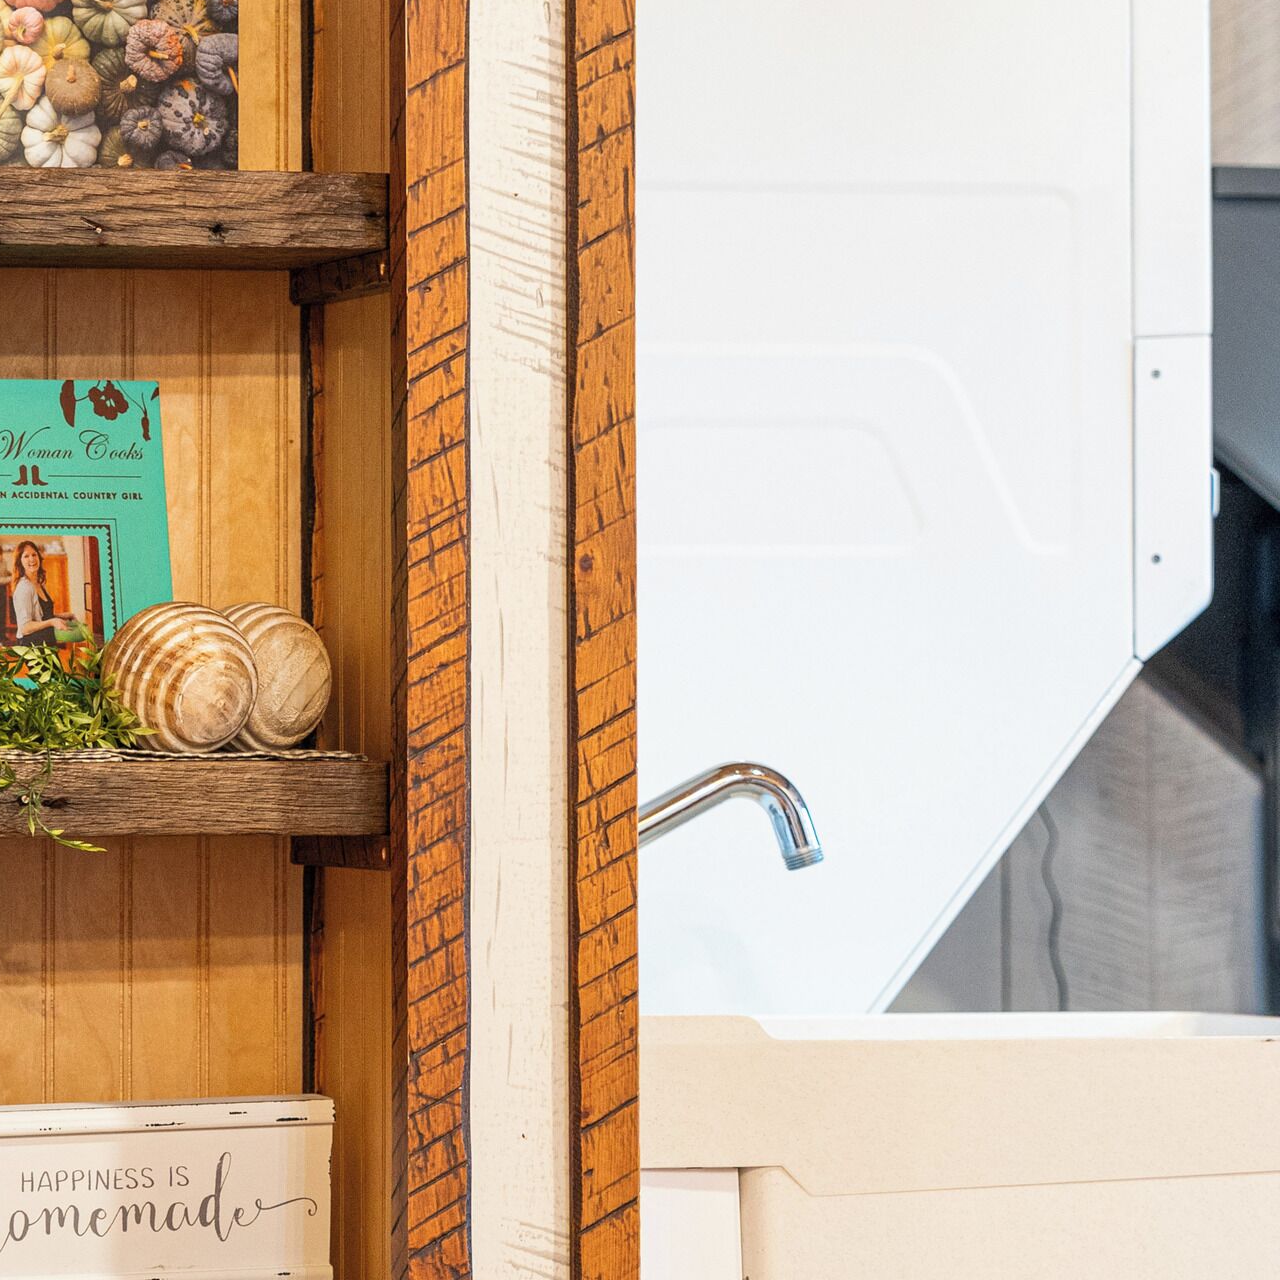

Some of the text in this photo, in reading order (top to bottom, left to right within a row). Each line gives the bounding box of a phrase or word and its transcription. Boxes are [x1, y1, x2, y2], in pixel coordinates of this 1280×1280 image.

[79, 429, 144, 461] Cooks
[11, 491, 69, 500] ACCIDENTAL
[73, 491, 117, 500] COUNTRY
[121, 492, 143, 501] GIRL
[20, 1165, 190, 1193] HAPPINESS IS
